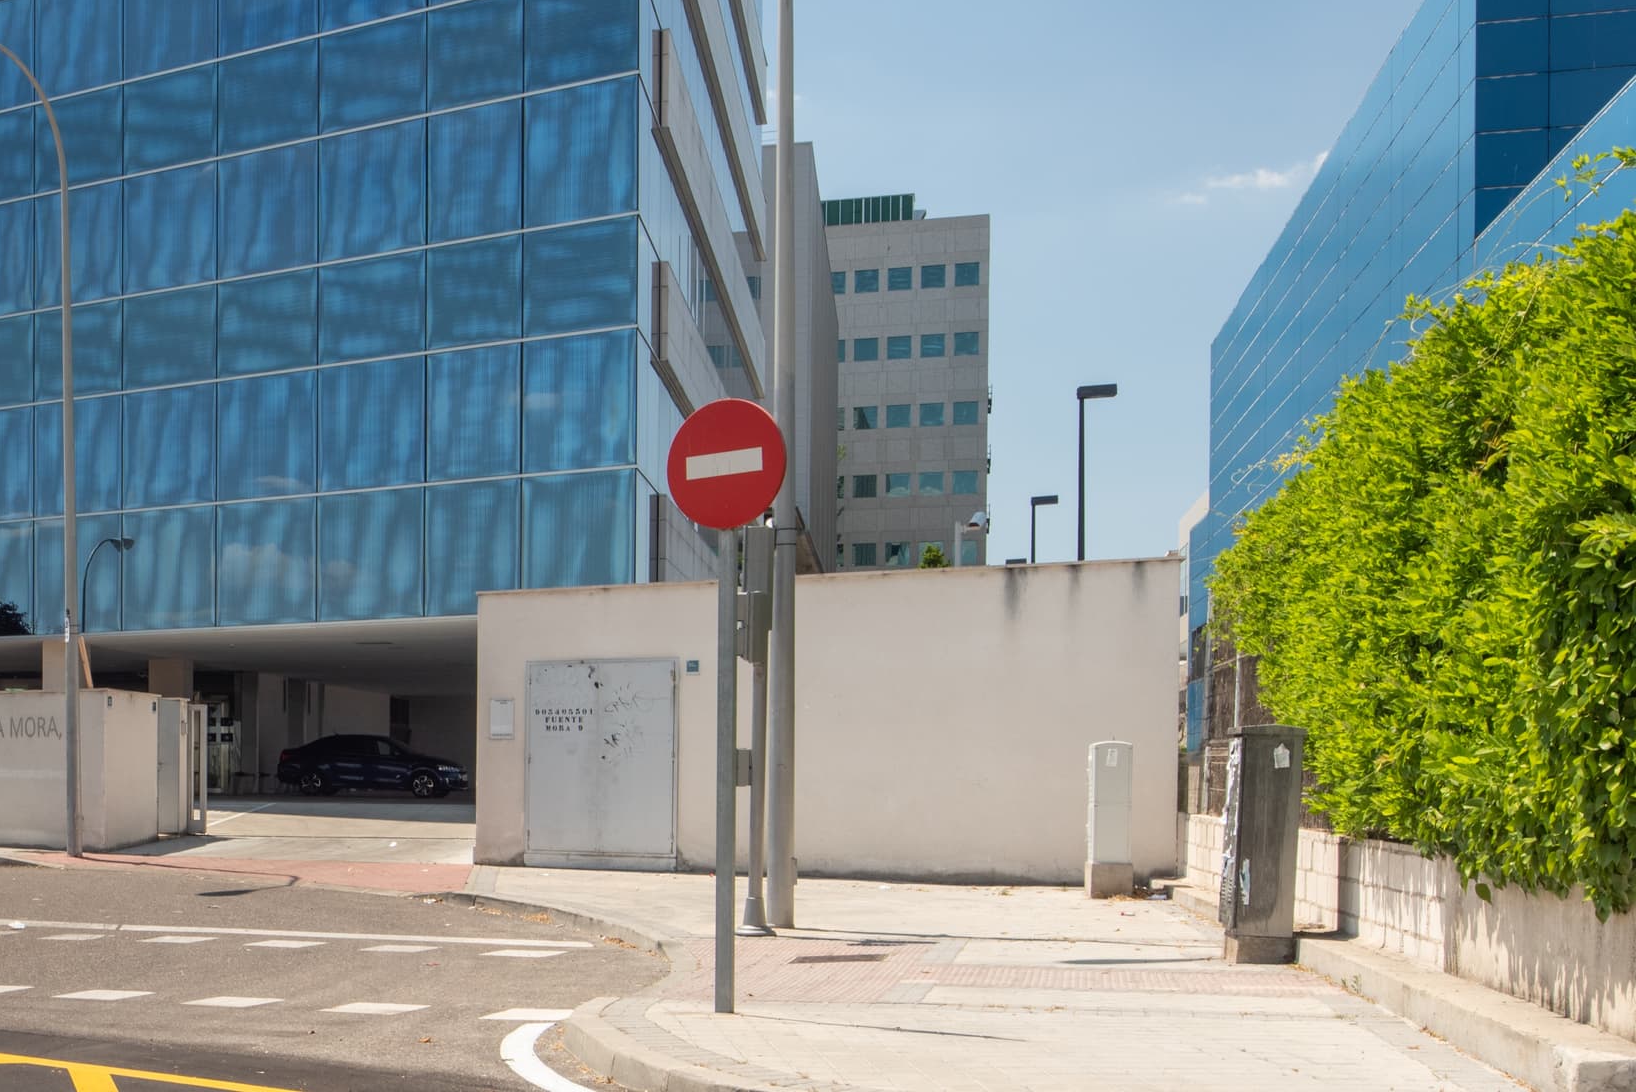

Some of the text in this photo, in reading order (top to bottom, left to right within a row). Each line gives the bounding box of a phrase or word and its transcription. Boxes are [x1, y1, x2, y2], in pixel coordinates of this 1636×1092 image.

[544, 716, 584, 724] FUENTE
[9, 715, 63, 741] MORA,
[545, 724, 571, 732] MORA
